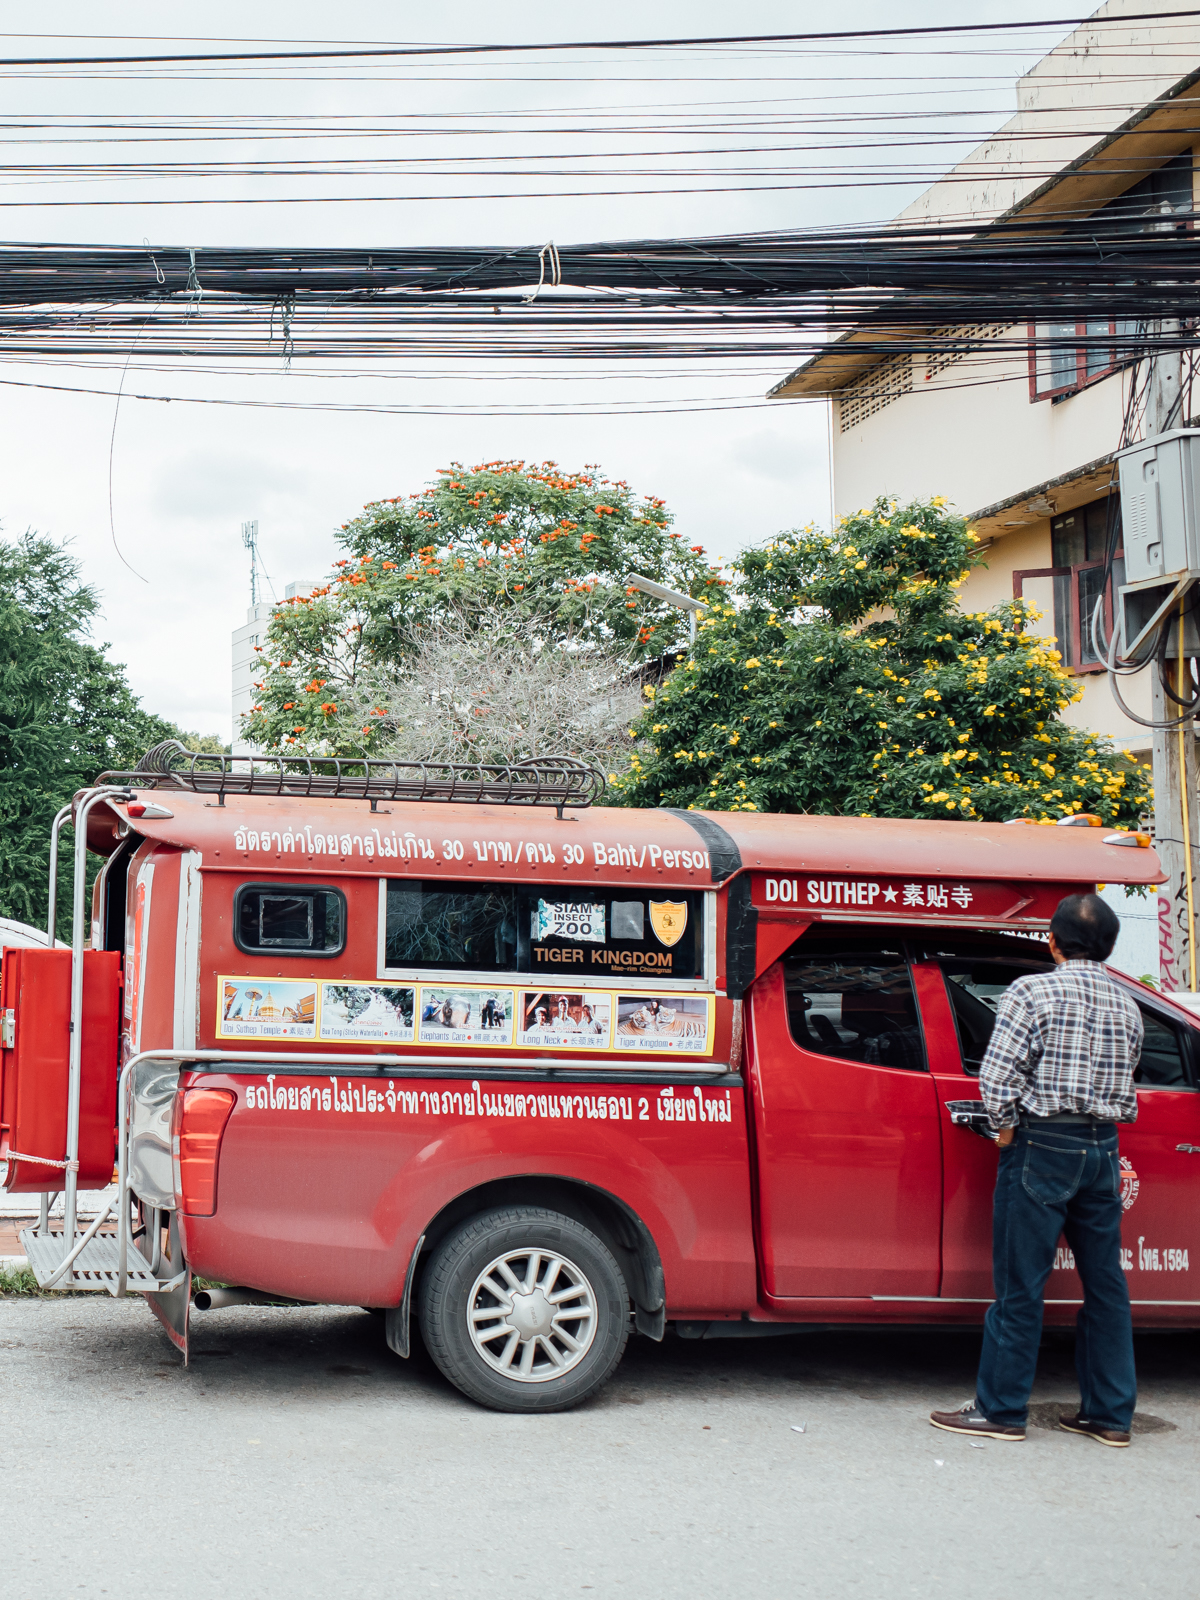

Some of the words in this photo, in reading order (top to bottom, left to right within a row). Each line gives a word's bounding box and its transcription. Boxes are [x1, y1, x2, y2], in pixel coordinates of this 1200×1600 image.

[234, 825, 435, 859] อัตราค่าโดยสารไม่เกิน
[442, 839, 464, 860] 30
[473, 840, 556, 864] บาท/คน
[562, 843, 585, 865] 30
[765, 878, 798, 902] DOI
[806, 880, 881, 905] SUTHEP
[902, 883, 974, 909] 素贴寺
[553, 902, 592, 914] SIAM
[553, 913, 592, 922] INSECT
[554, 922, 592, 935] ZOO
[534, 947, 584, 963] TIGER
[591, 949, 673, 967] KINGDOM
[223, 1023, 234, 1033] Doi
[236, 1024, 257, 1035] Suthep
[260, 1025, 281, 1036] Temple
[331, 1027, 343, 1037] Tong
[420, 1030, 450, 1041] Elephants
[451, 1032, 466, 1041] Care
[522, 1034, 540, 1045] Long
[543, 1035, 561, 1045] Neck
[619, 1038, 637, 1048] Tiger
[639, 1038, 669, 1049] Kingdom
[637, 1097, 650, 1121] 2
[656, 1086, 732, 1123] เชียงใหม่
[1138, 1235, 1189, 1271] โทร.1584
